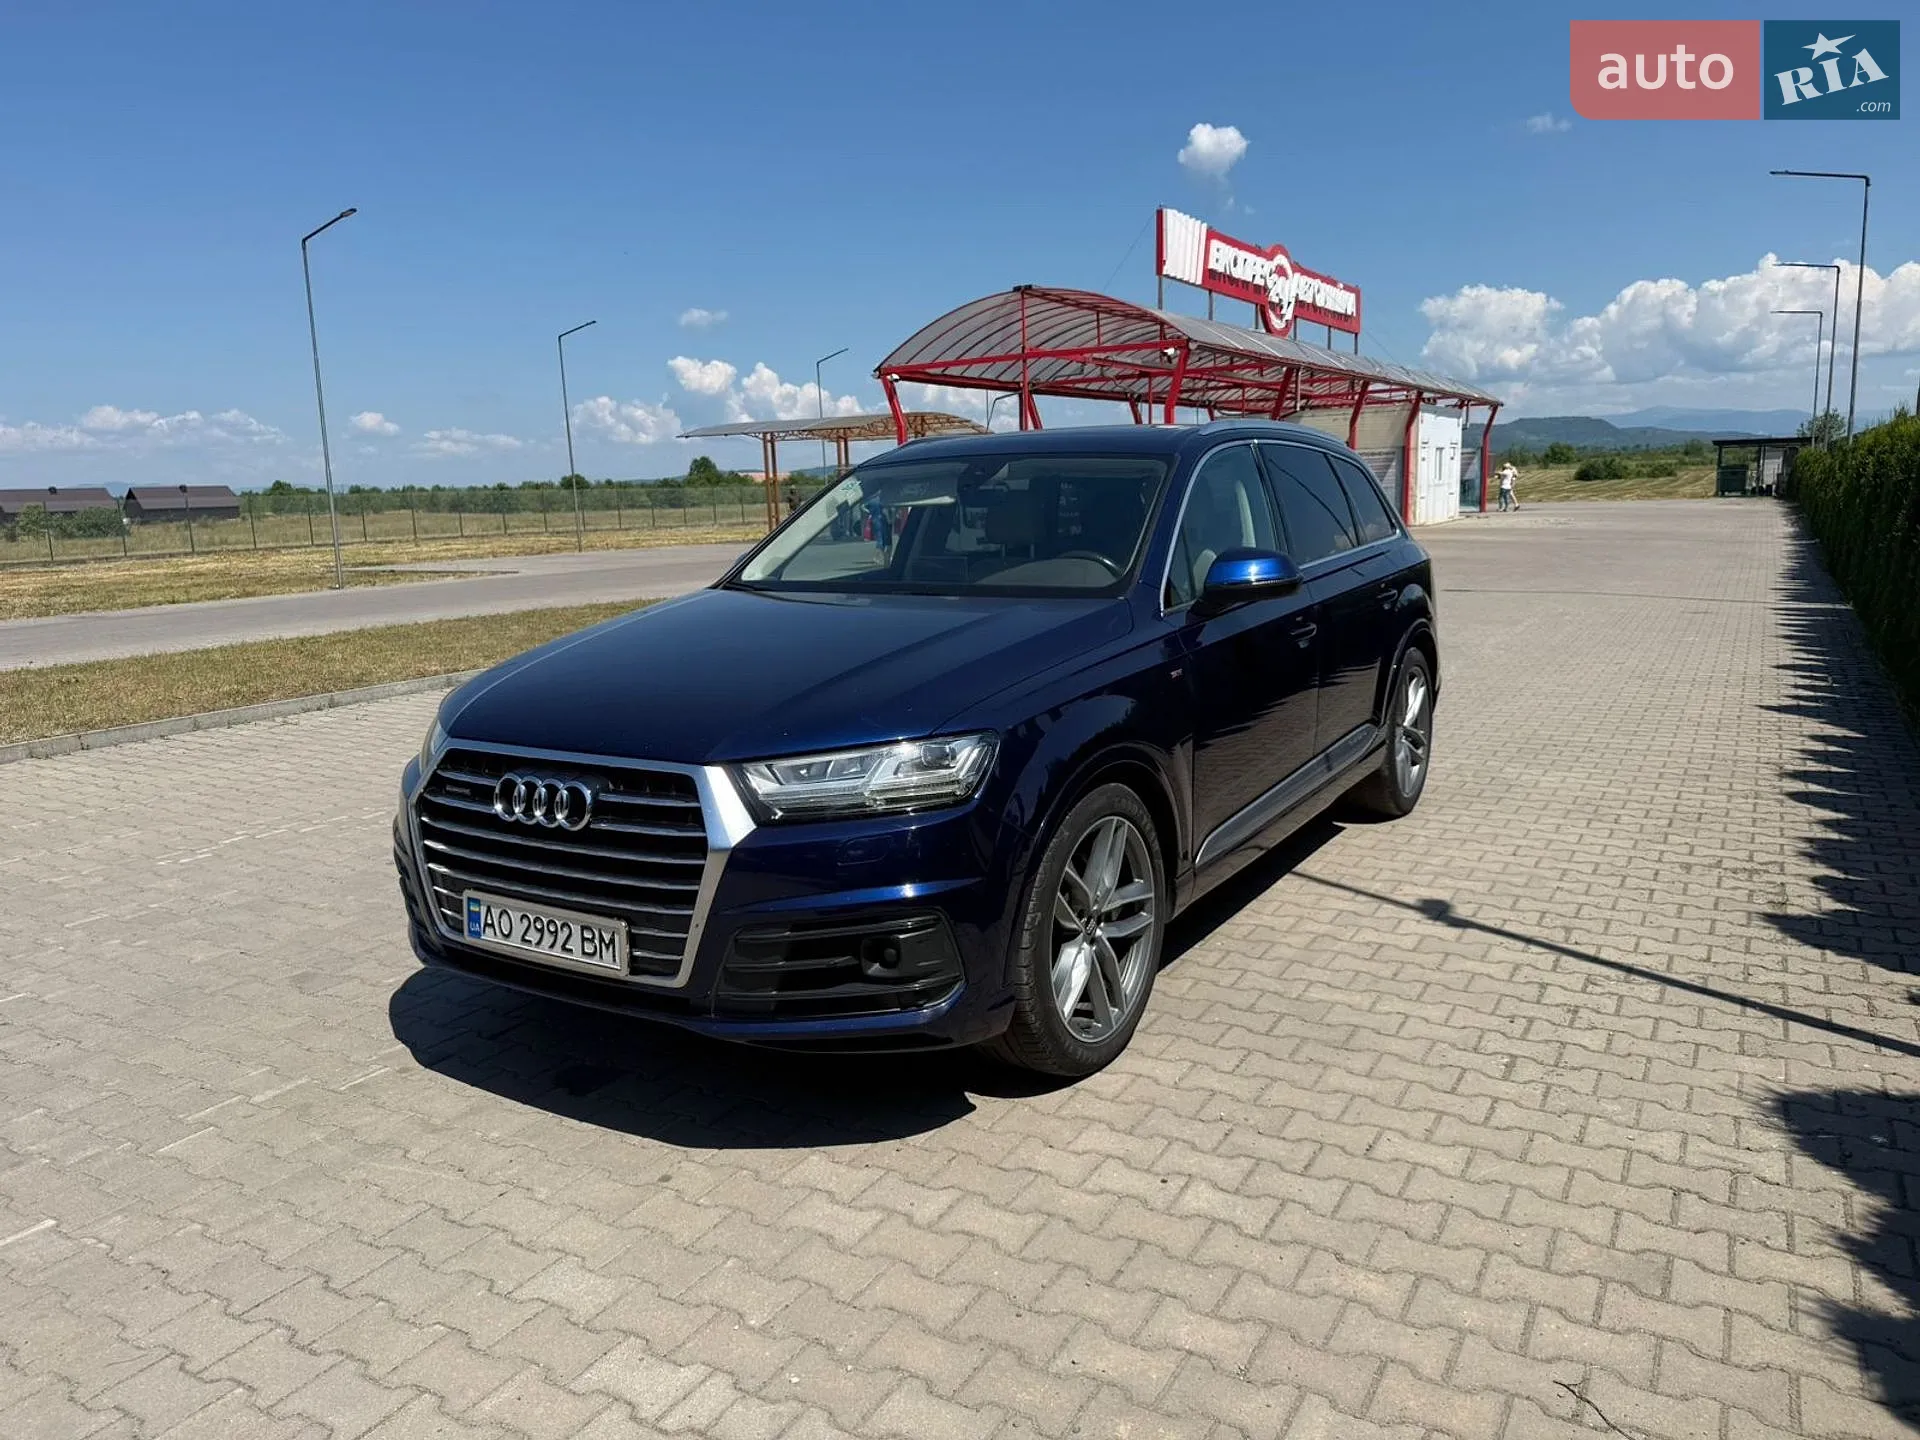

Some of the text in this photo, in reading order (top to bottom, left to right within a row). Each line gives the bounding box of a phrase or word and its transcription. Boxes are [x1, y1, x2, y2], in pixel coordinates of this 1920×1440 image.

[470, 921, 481, 932] UA
[483, 905, 618, 963] AO 2992 BM
